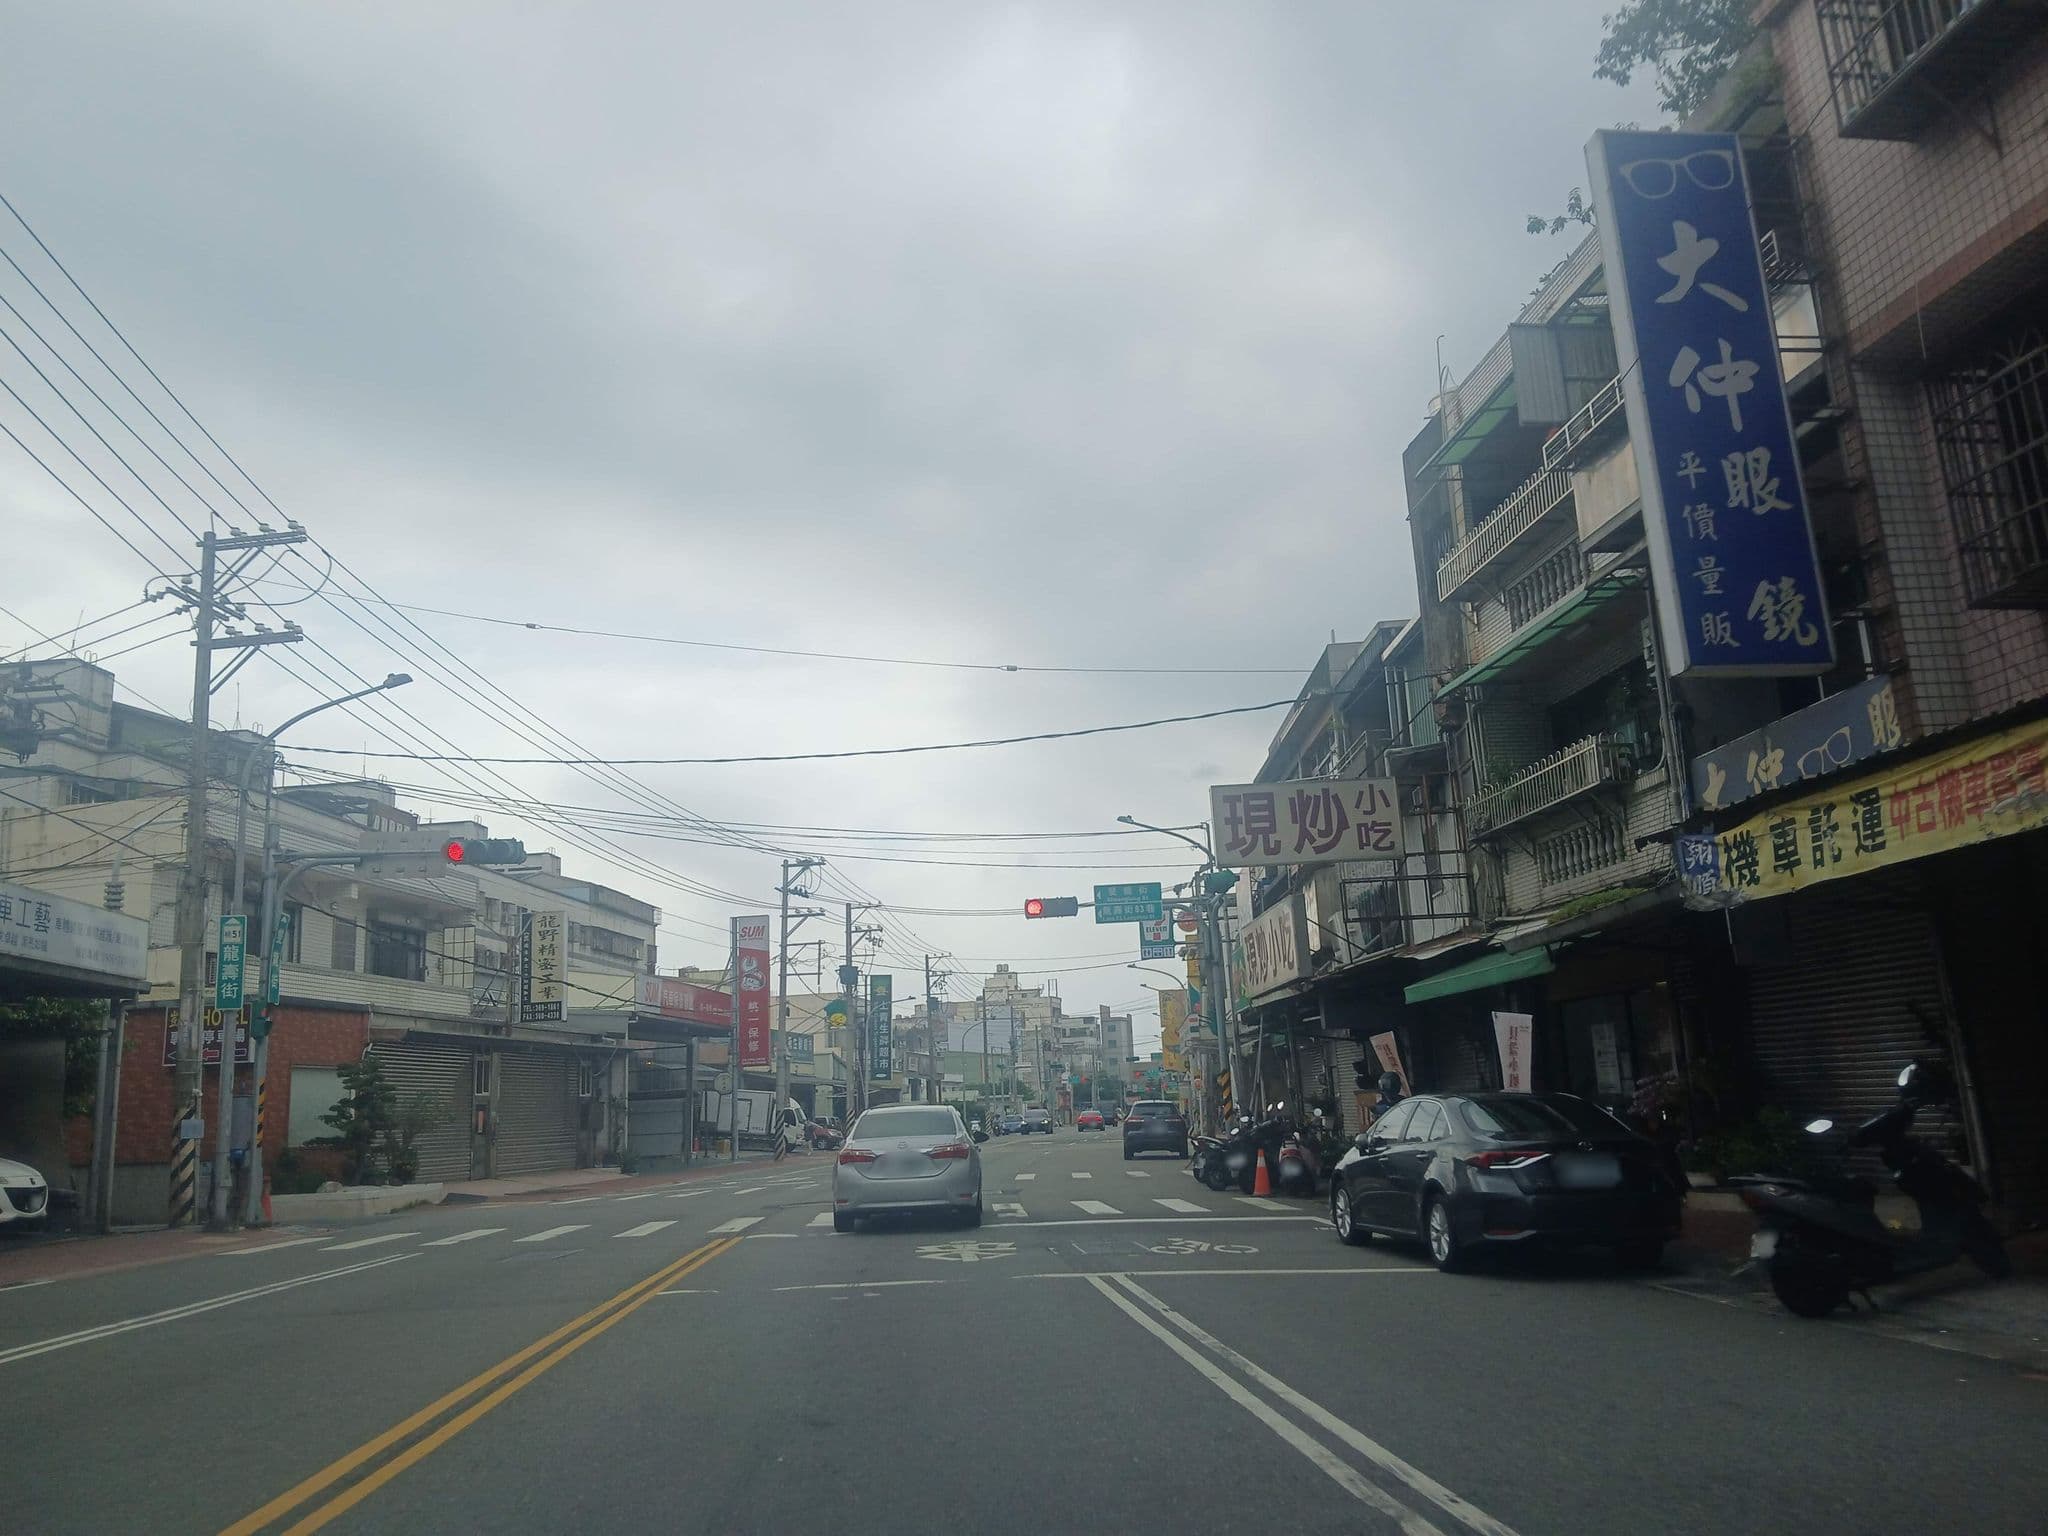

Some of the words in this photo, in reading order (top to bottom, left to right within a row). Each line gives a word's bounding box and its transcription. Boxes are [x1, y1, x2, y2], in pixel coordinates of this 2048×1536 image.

[1655, 219, 1819, 647] 大仲眼鏡
[1676, 451, 1742, 648] 平價量販
[1222, 786, 1350, 858] 現炒
[1354, 783, 1396, 852] 小吃
[1723, 786, 1888, 888] 機車託運
[740, 925, 766, 938] SUM
[1244, 910, 1296, 987] 現炒小吃
[221, 945, 240, 999] 龍壽街
[202, 1007, 249, 1027] HOL
